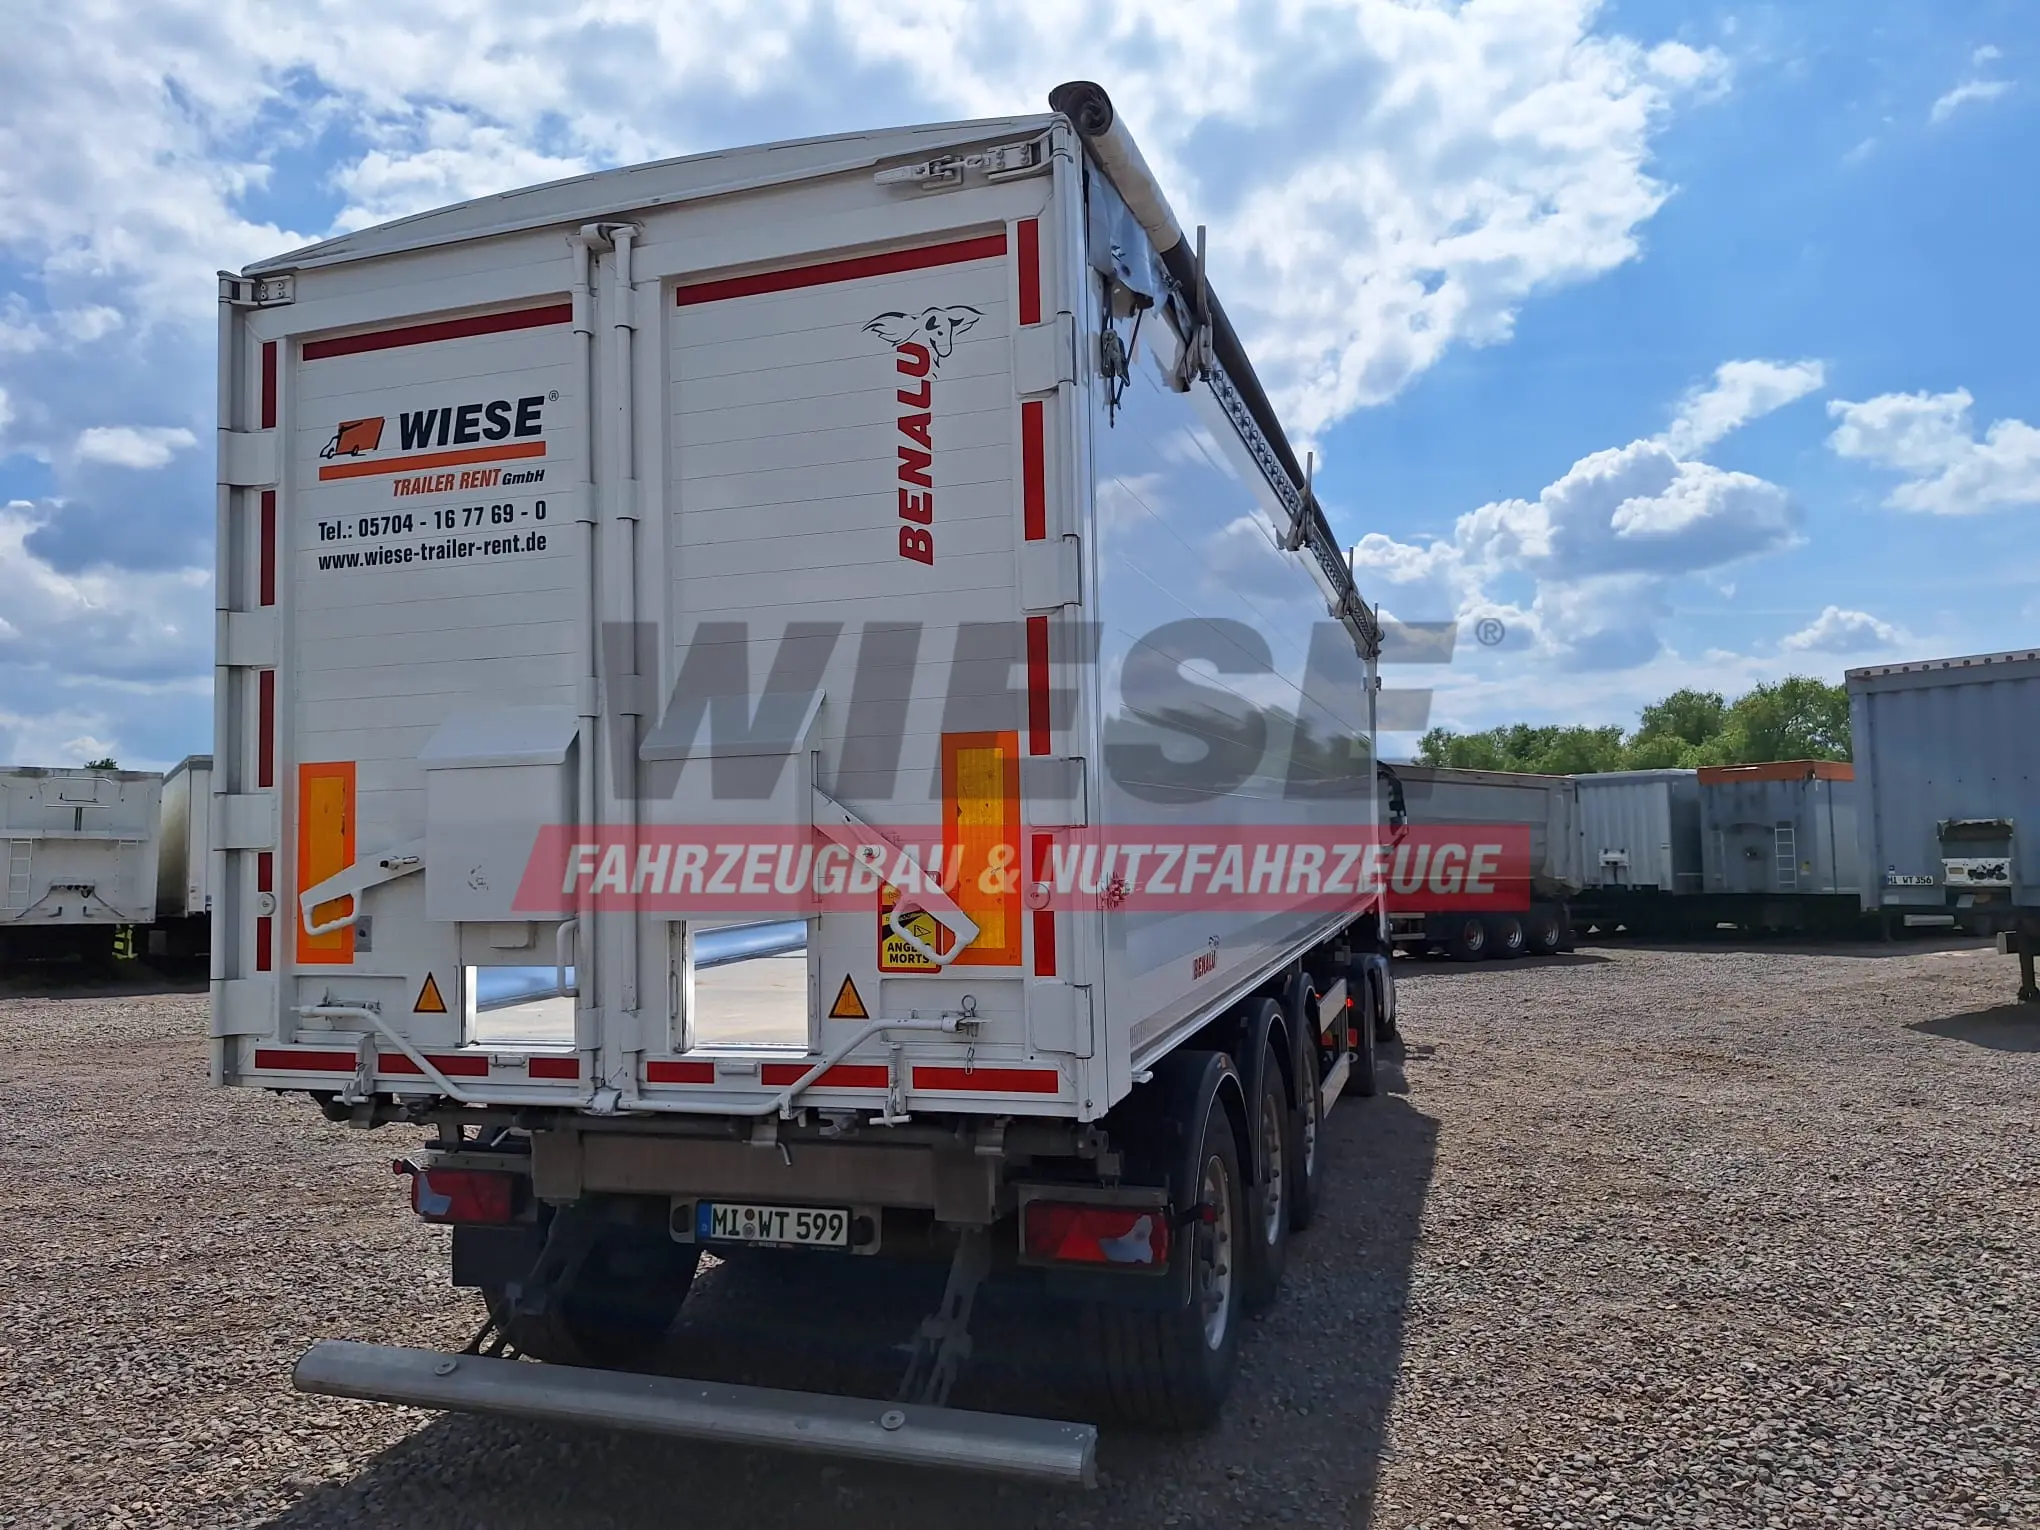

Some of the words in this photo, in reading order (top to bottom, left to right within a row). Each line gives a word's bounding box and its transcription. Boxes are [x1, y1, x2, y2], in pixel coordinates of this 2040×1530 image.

[400, 395, 545, 451] WIESE
[896, 341, 934, 566] BENALU
[393, 474, 455, 497] TRAILER
[459, 468, 502, 490] RENT
[502, 469, 545, 486] GmbH
[318, 521, 353, 541] Tel.:
[358, 513, 414, 538] 05704
[434, 509, 456, 530] 16
[462, 506, 485, 526] 77
[491, 503, 514, 525] 69
[535, 500, 547, 520] 0
[318, 531, 547, 571] www.wiese-trailer-rent.de
[712, 1208, 740, 1236] MI
[758, 1210, 790, 1239] WT
[796, 1212, 843, 1241] 599
